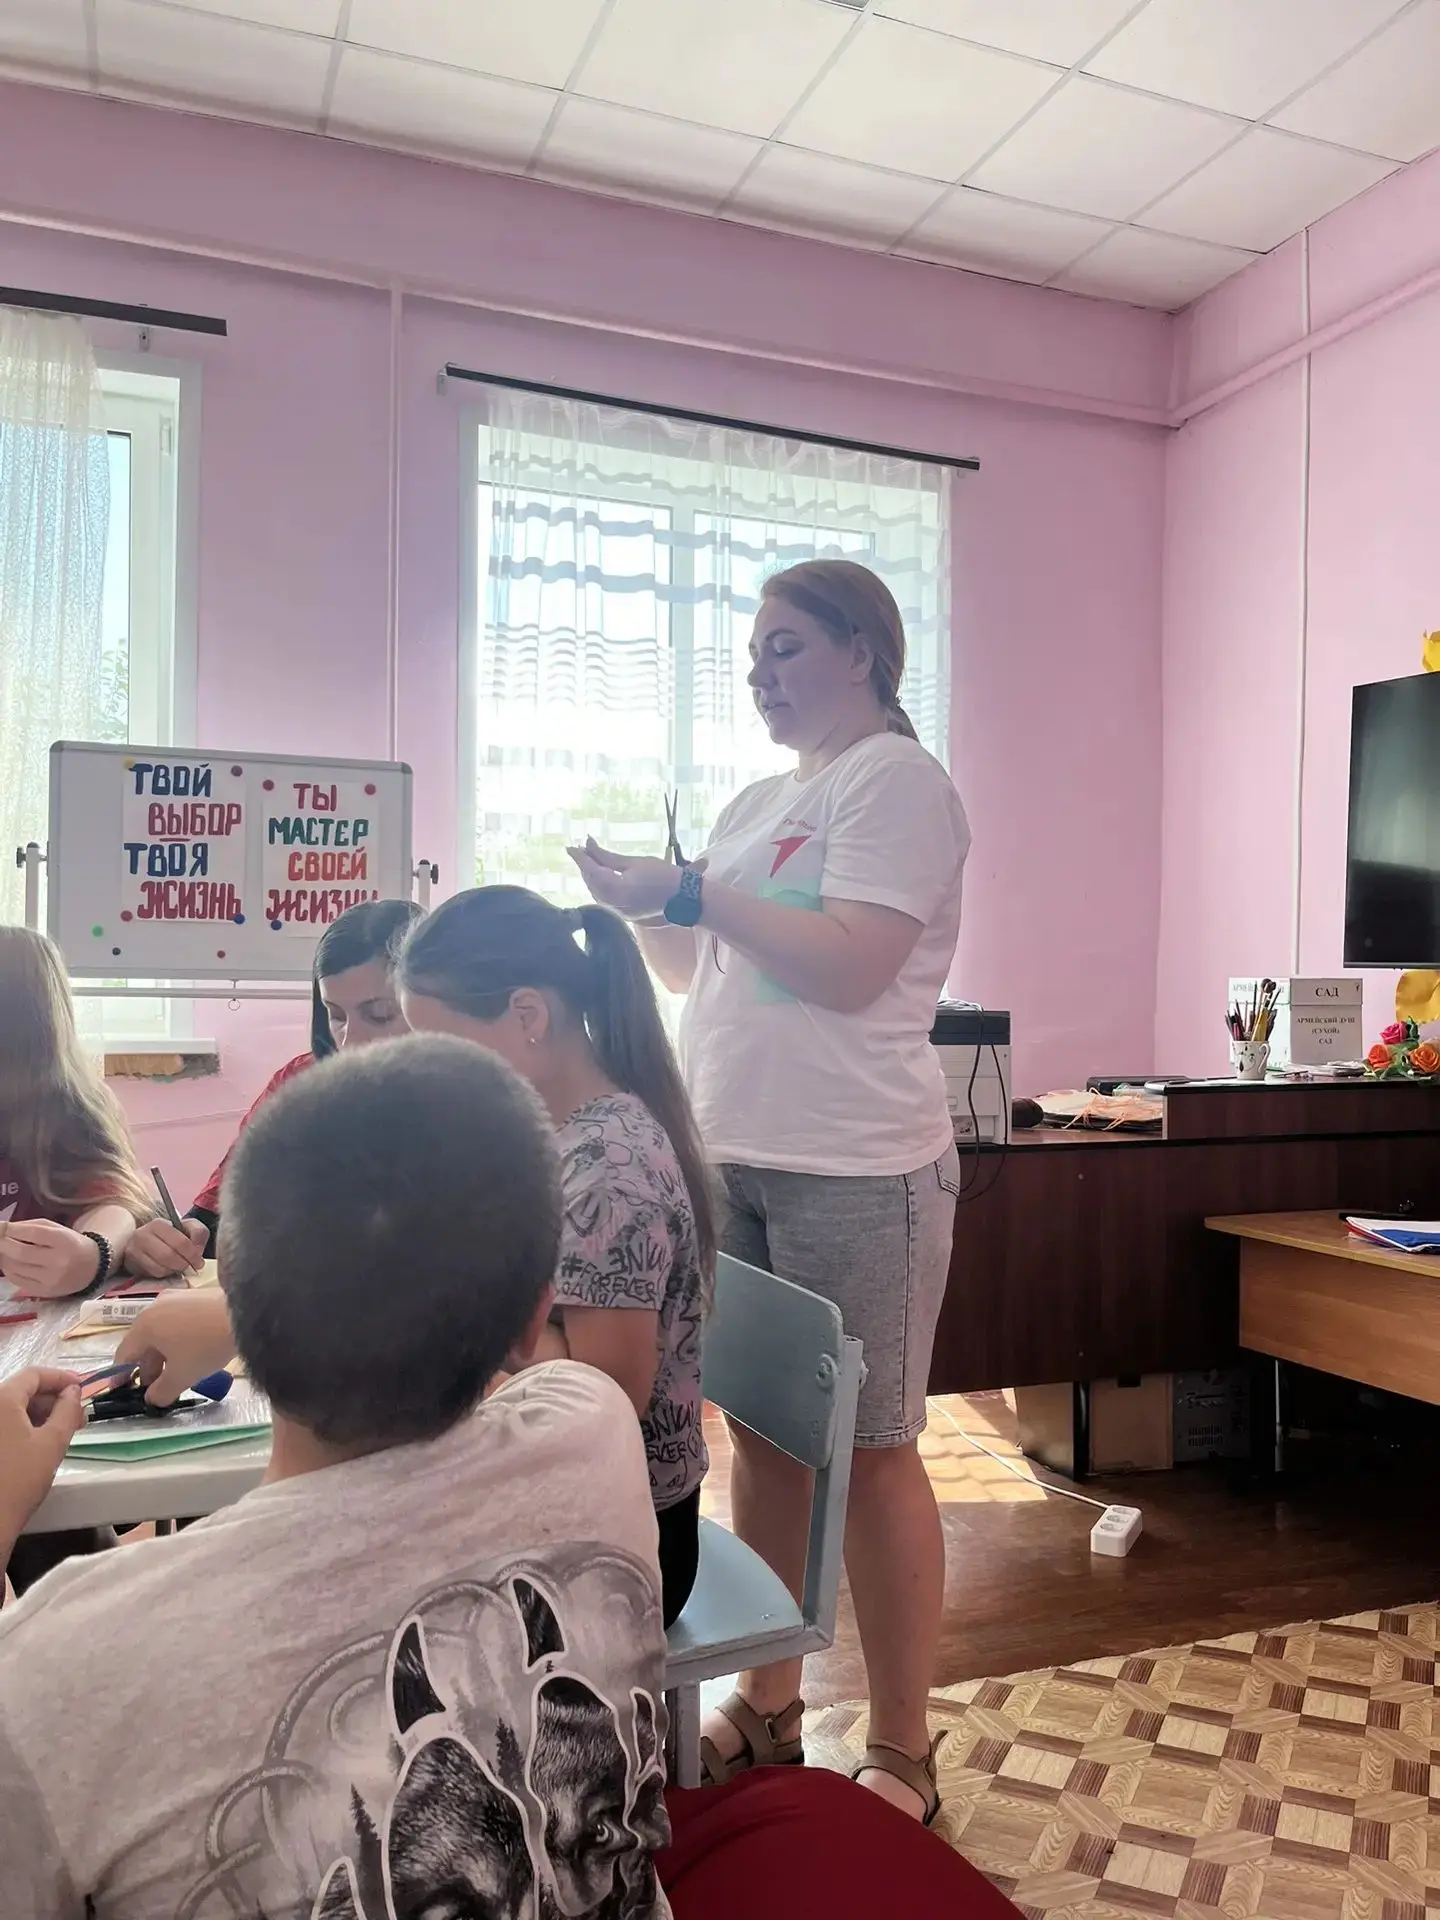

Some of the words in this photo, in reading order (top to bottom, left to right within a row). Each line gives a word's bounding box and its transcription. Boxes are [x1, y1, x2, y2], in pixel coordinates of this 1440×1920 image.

[128, 762, 212, 797] ТВОЙ
[293, 783, 337, 811] ТЫ
[149, 802, 242, 836] ВЫБОР
[268, 817, 369, 846] МАСТЕР
[124, 842, 208, 877] ТВОЯ
[288, 846, 368, 881] СВОЕЙ
[137, 880, 242, 920] ЖИЗНЬ
[265, 889, 379, 923] ЖИЗ
[1315, 986, 1339, 997] САД
